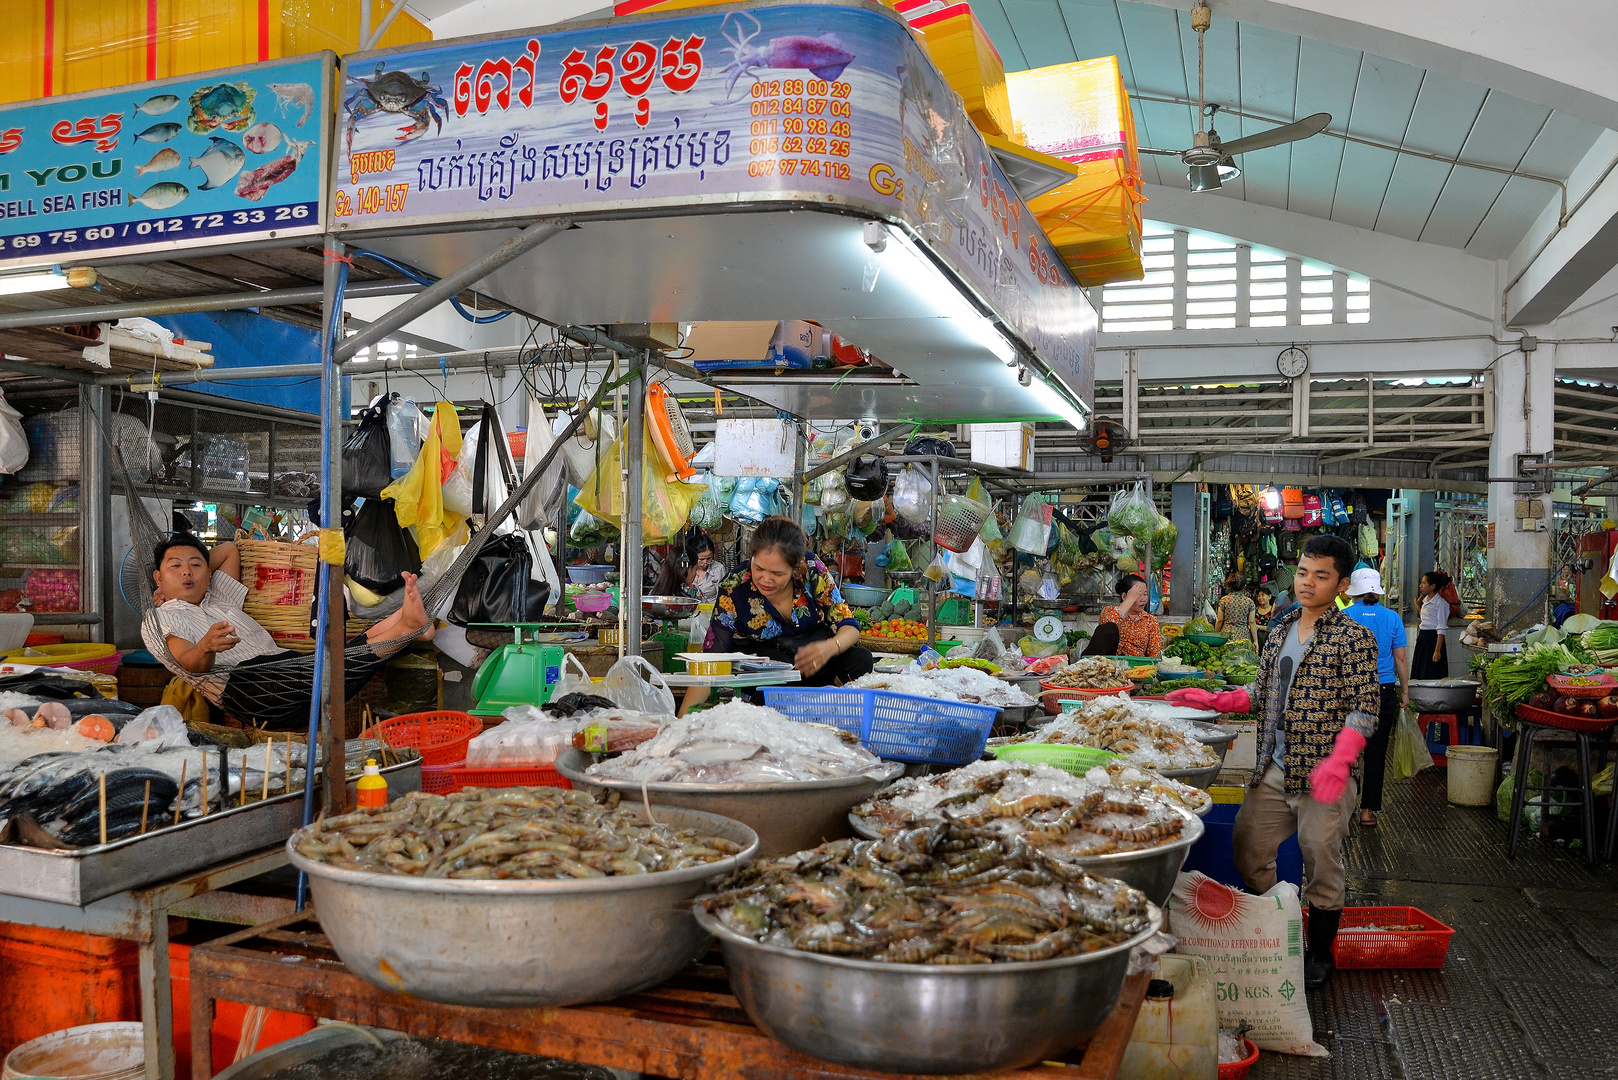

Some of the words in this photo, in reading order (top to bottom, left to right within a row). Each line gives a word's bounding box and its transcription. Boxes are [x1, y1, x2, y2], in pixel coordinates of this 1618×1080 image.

[751, 80, 780, 98] 012
[783, 79, 804, 96] 88
[807, 79, 828, 96] 00
[831, 81, 852, 99] 29
[750, 99, 779, 117] 012
[782, 98, 803, 115] 84
[806, 98, 828, 115] 87
[830, 100, 851, 118] 04
[750, 118, 778, 136] 011
[782, 118, 804, 134] 90
[806, 118, 828, 135] 98
[830, 120, 851, 138] 48
[749, 137, 779, 155] 015
[782, 136, 802, 153] 62
[806, 137, 827, 155] 62
[829, 139, 850, 157] 25
[25, 158, 122, 187] YOU
[748, 159, 776, 177] 097
[779, 159, 798, 176] 97
[800, 159, 821, 176] 74
[823, 161, 851, 181] 112
[43, 194, 77, 214] SEA
[81, 187, 122, 210] FISH
[358, 183, 409, 215] 140-157
[12, 235, 41, 248] 69
[49, 230, 78, 245] 75
[85, 226, 115, 241] 60
[136, 218, 183, 235] 012
[192, 214, 224, 229] 72
[232, 210, 266, 225] 33
[274, 205, 309, 221] 26
[1188, 937, 1230, 948] CONDITIONED
[1231, 939, 1258, 949] REFINED
[1259, 938, 1281, 948] SUGAR
[1216, 981, 1239, 1002] 50
[1244, 986, 1273, 999] KGS.
